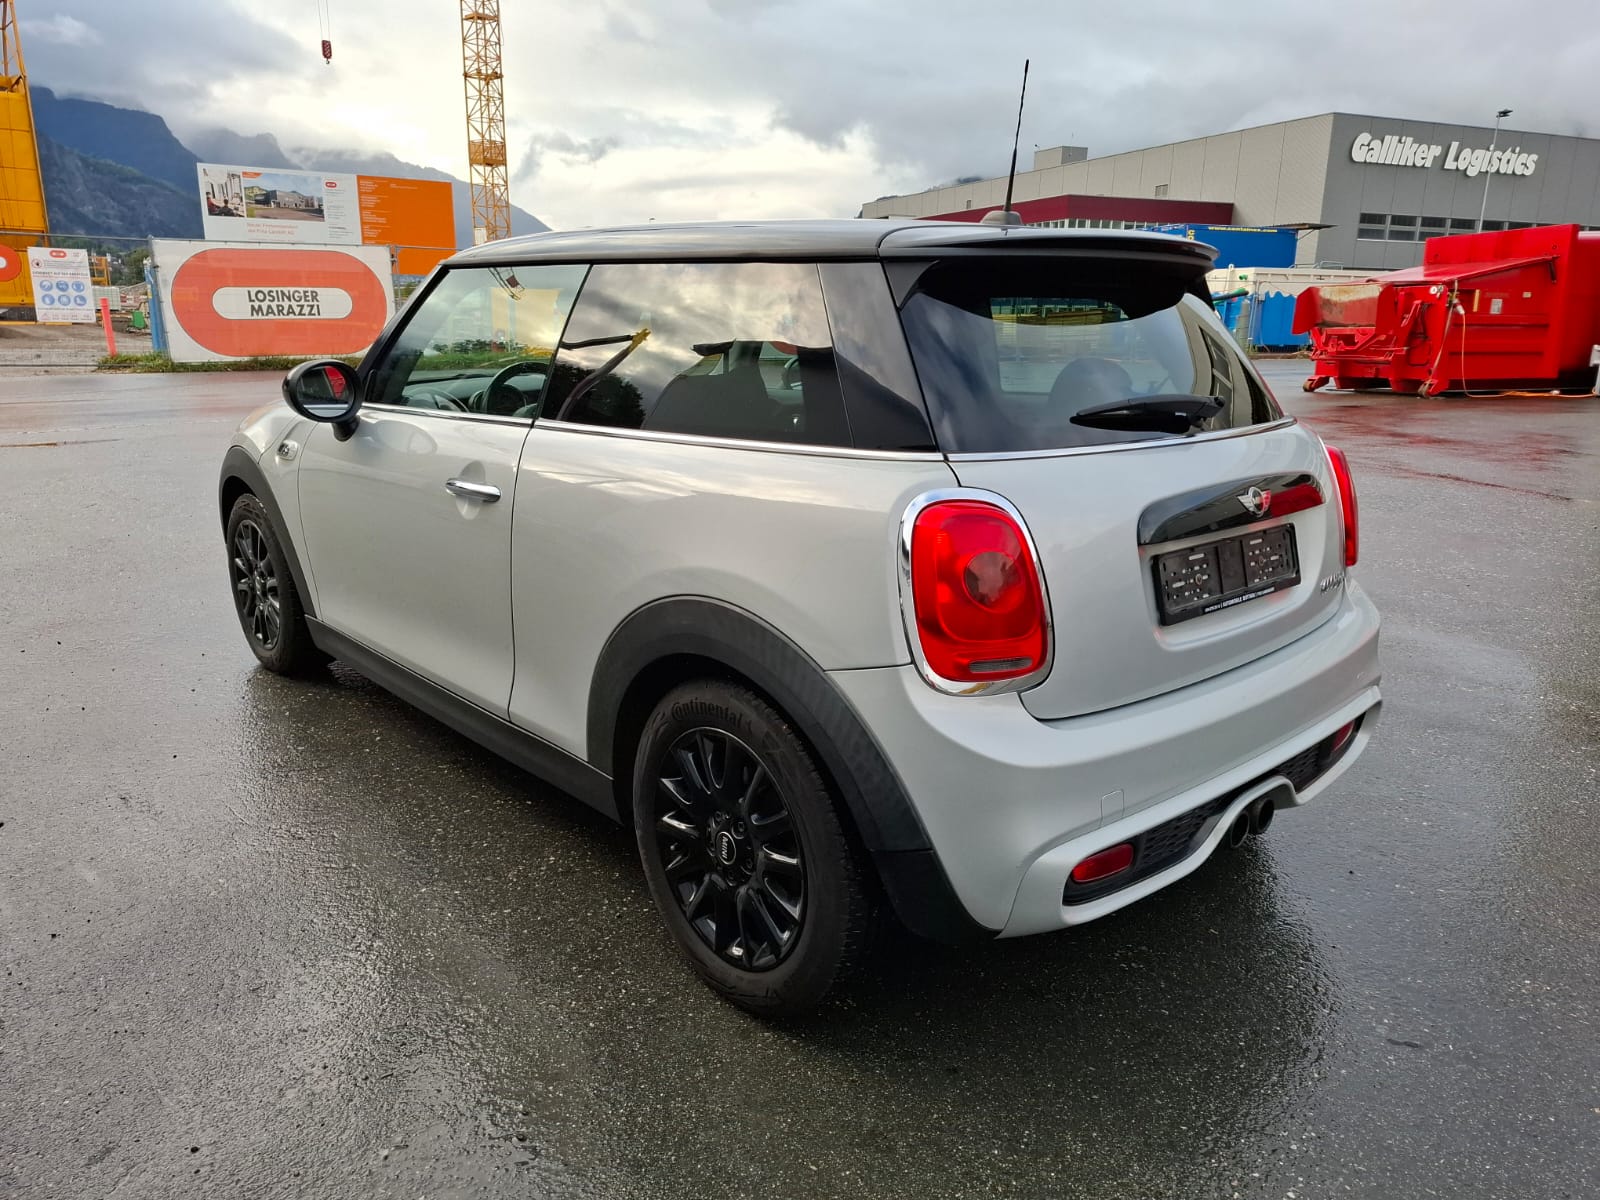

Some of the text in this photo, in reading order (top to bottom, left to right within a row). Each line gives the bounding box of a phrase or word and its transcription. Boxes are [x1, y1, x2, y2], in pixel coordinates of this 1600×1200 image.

[1351, 132, 1539, 177] Galliker Logistics
[247, 289, 320, 303] LOSINGER
[250, 304, 321, 317] MARAZZI
[671, 697, 743, 729] Continental
[721, 836, 729, 860] MINI
